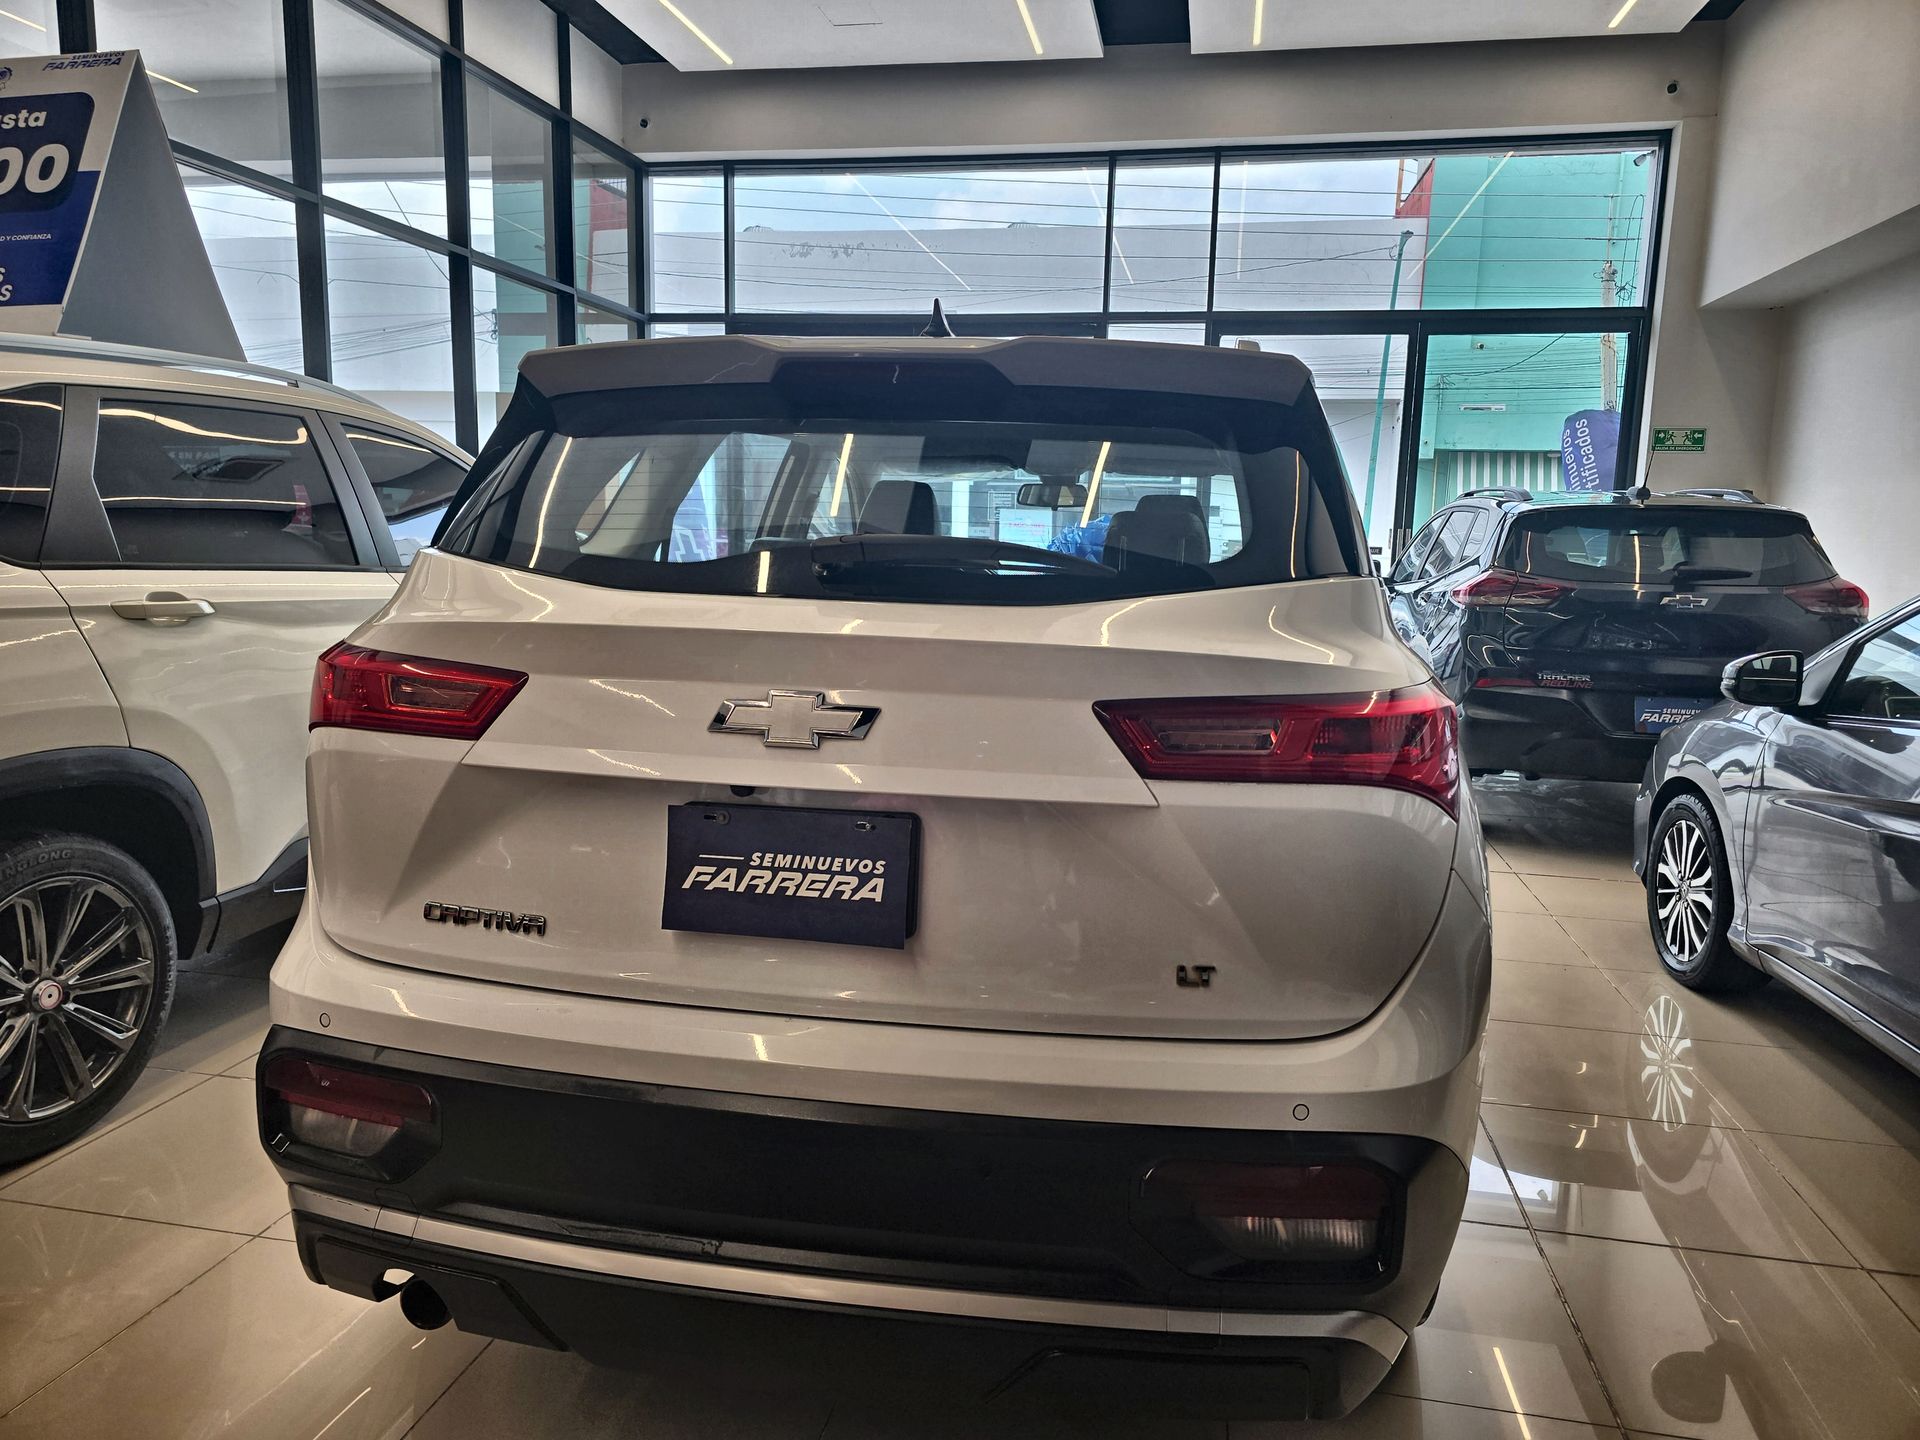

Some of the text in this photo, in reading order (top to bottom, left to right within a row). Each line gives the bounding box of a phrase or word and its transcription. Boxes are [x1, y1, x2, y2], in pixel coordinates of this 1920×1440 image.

[42, 57, 122, 71] FARRERA
[72, 51, 125, 61] SEMINUEVOS
[0, 109, 47, 129] sta
[12, 233, 52, 241] CONFIANZA
[1563, 428, 1581, 492] inuevos
[1575, 418, 1602, 492] tificados
[749, 851, 887, 876] SEMINUEVOS
[681, 865, 886, 904] FARRERA
[423, 900, 547, 937] CAPTIVA
[1176, 964, 1218, 989] LT
